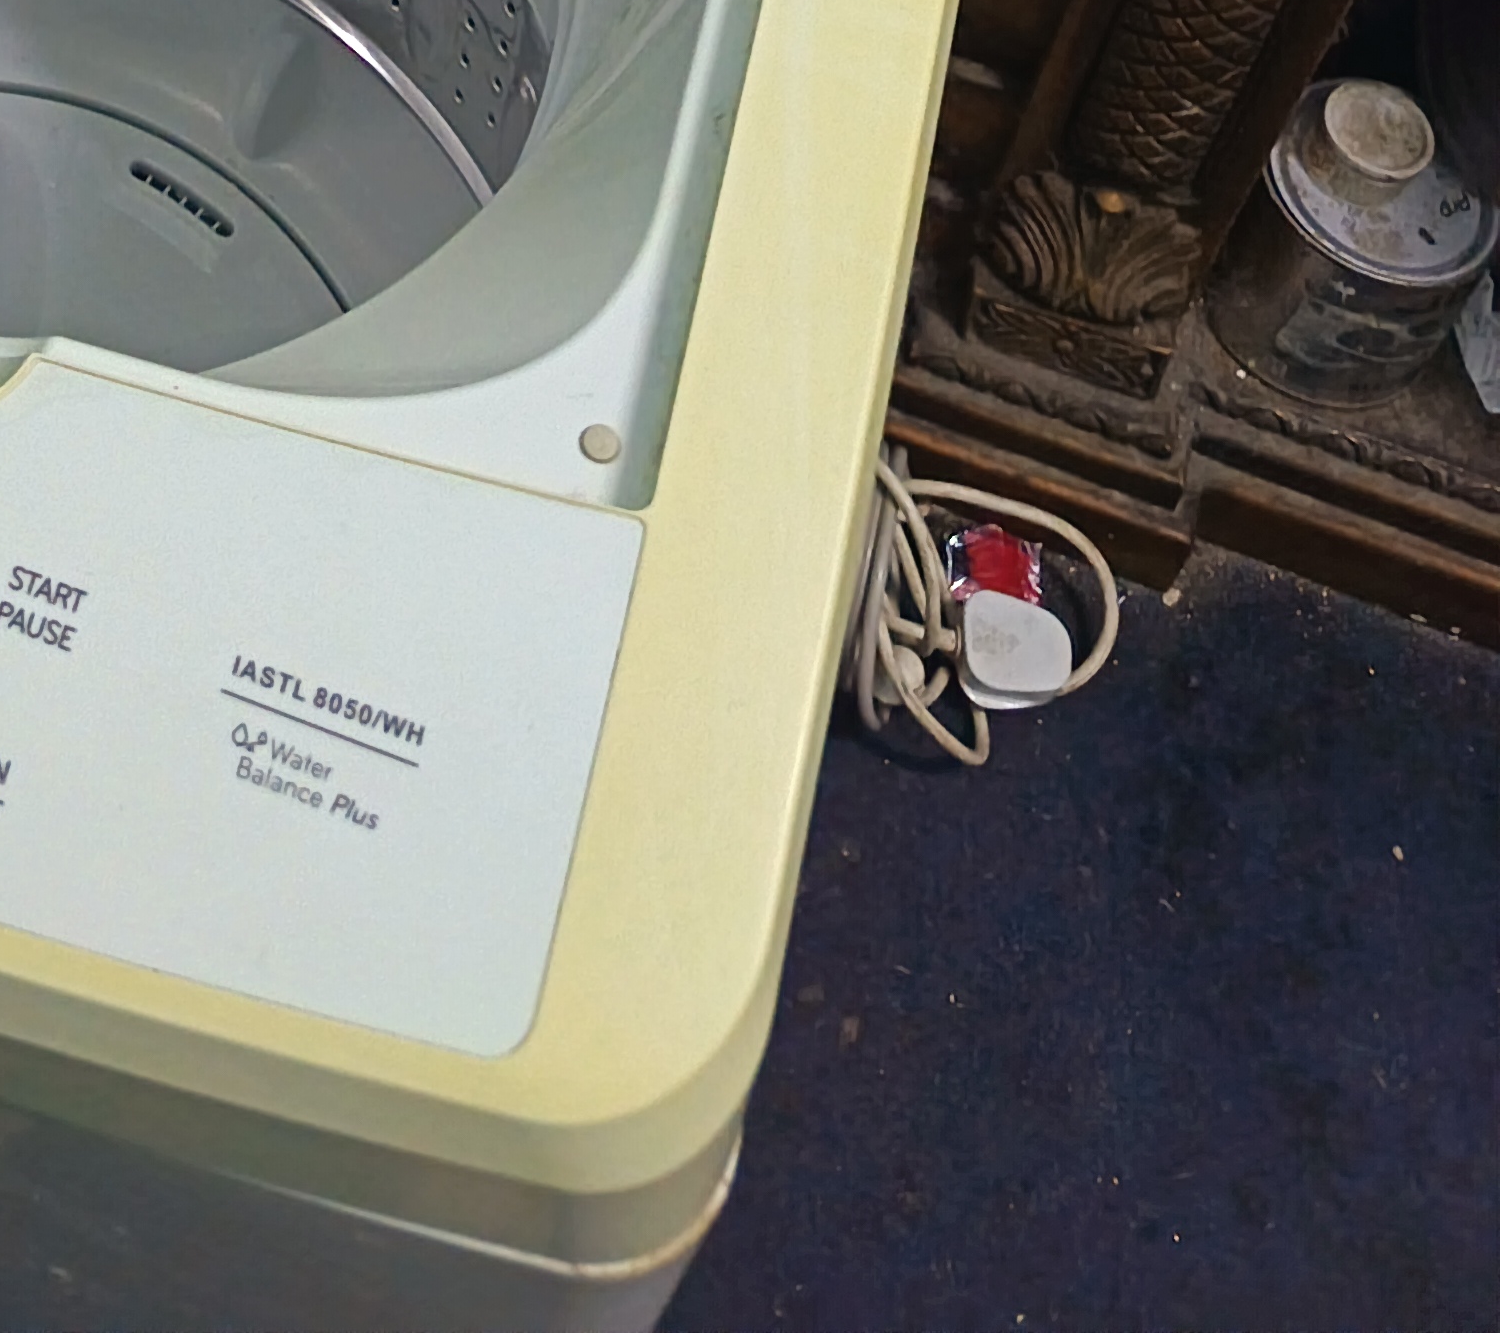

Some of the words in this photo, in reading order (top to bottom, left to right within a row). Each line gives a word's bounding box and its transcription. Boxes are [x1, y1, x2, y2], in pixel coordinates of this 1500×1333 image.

[7, 565, 88, 614] START
[231, 654, 306, 703] IASTL
[311, 686, 426, 748] 8050/WH
[270, 735, 333, 782] Water
[235, 755, 324, 810] Balance
[329, 793, 380, 831] Plus
